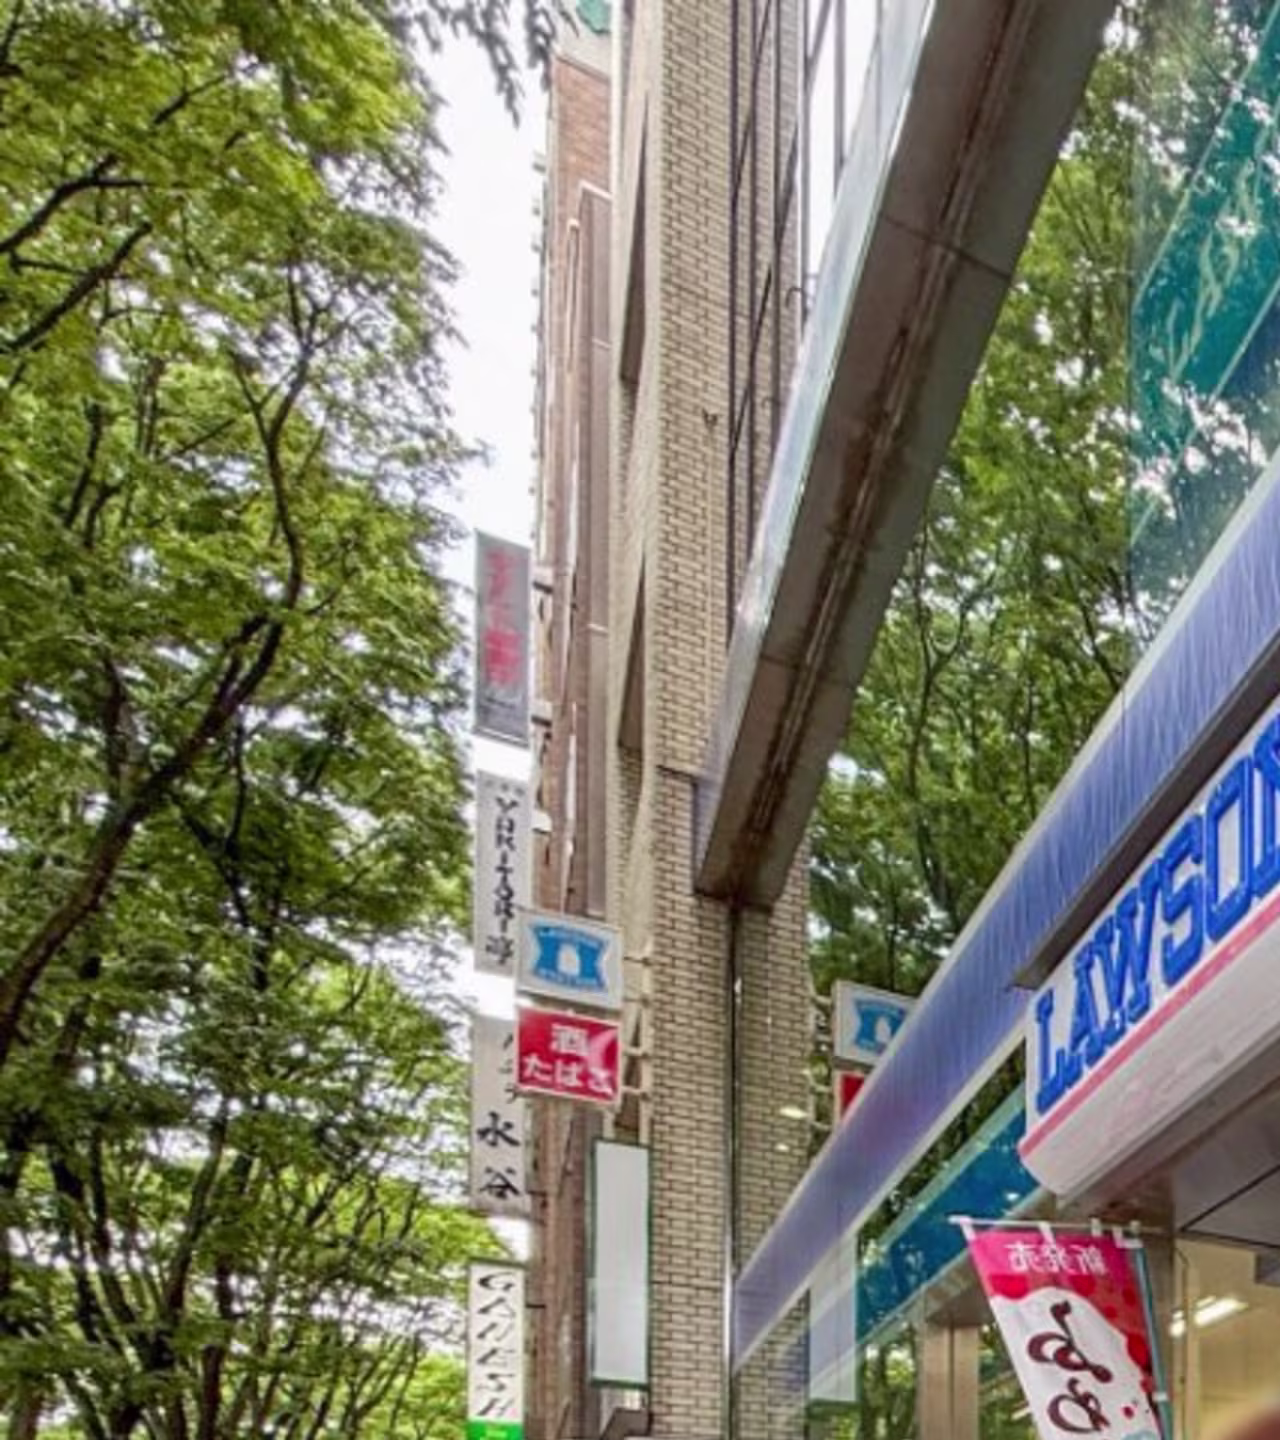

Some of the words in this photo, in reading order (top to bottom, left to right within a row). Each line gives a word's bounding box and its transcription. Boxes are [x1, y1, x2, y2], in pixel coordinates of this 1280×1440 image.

[521, 1052, 615, 1096] たばこ
[476, 1111, 521, 1199] 水谷
